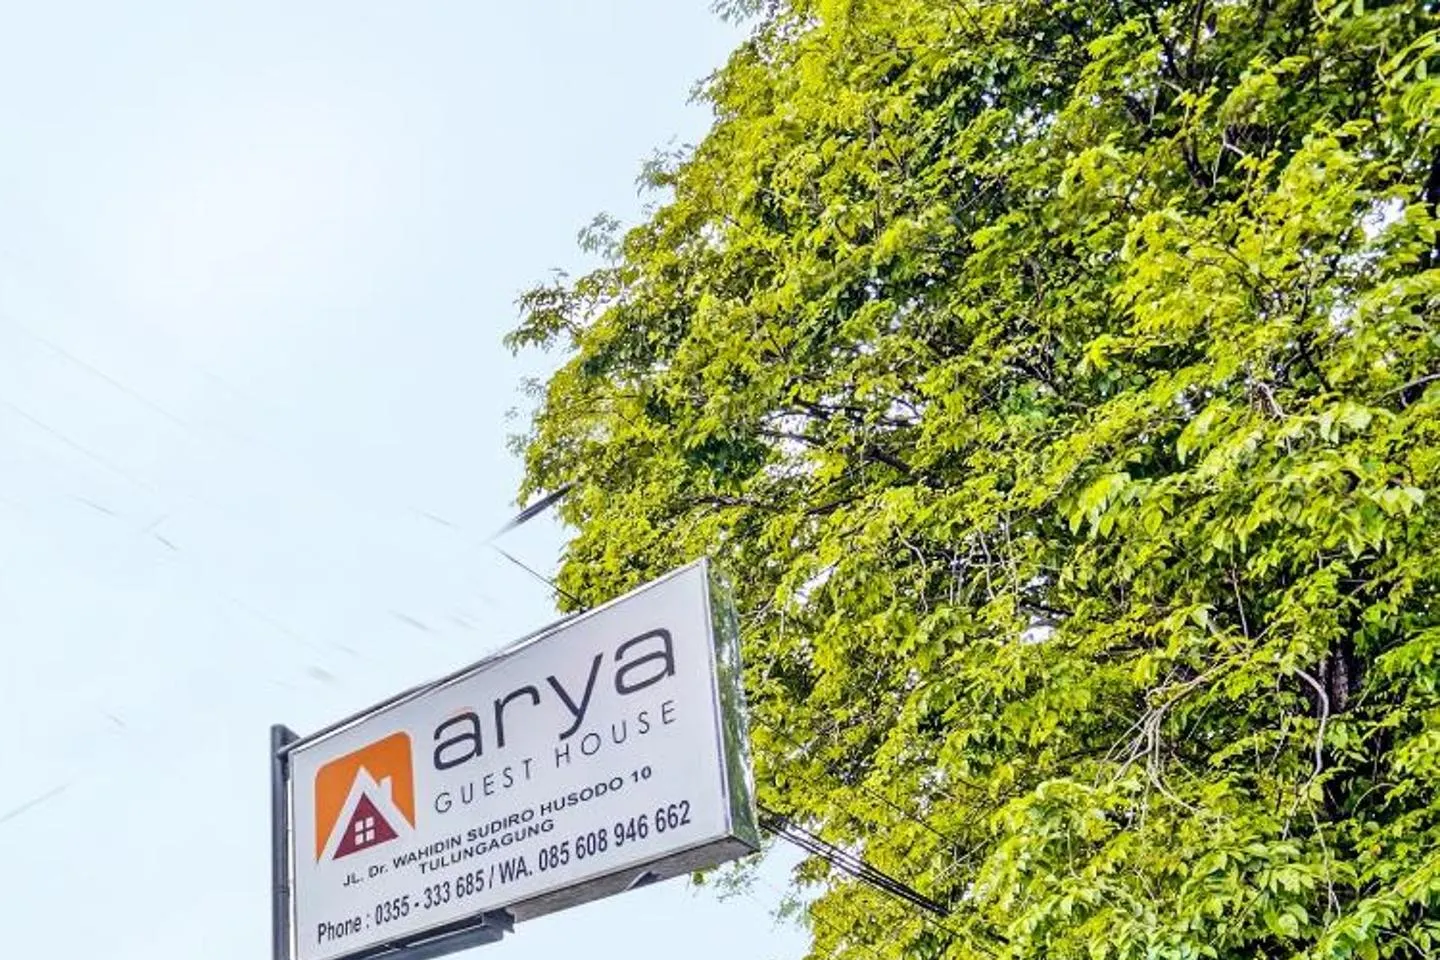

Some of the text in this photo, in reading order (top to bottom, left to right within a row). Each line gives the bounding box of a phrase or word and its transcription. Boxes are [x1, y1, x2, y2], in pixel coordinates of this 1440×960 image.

[433, 626, 676, 771] arya
[435, 699, 677, 814] GUEST HOUSE
[317, 917, 361, 945] Phone
[375, 895, 410, 926] 0355
[424, 881, 451, 910] 333
[456, 869, 485, 899] 685
[498, 855, 533, 884] WA.
[539, 840, 570, 872] 085
[575, 828, 608, 860] 608
[614, 814, 649, 847] 946
[655, 800, 691, 833] 662
[343, 766, 652, 887] JL. Dr. WAHIDIN SUDIRO HUSODO 10
[419, 819, 554, 874] TULUNGAGUNG
